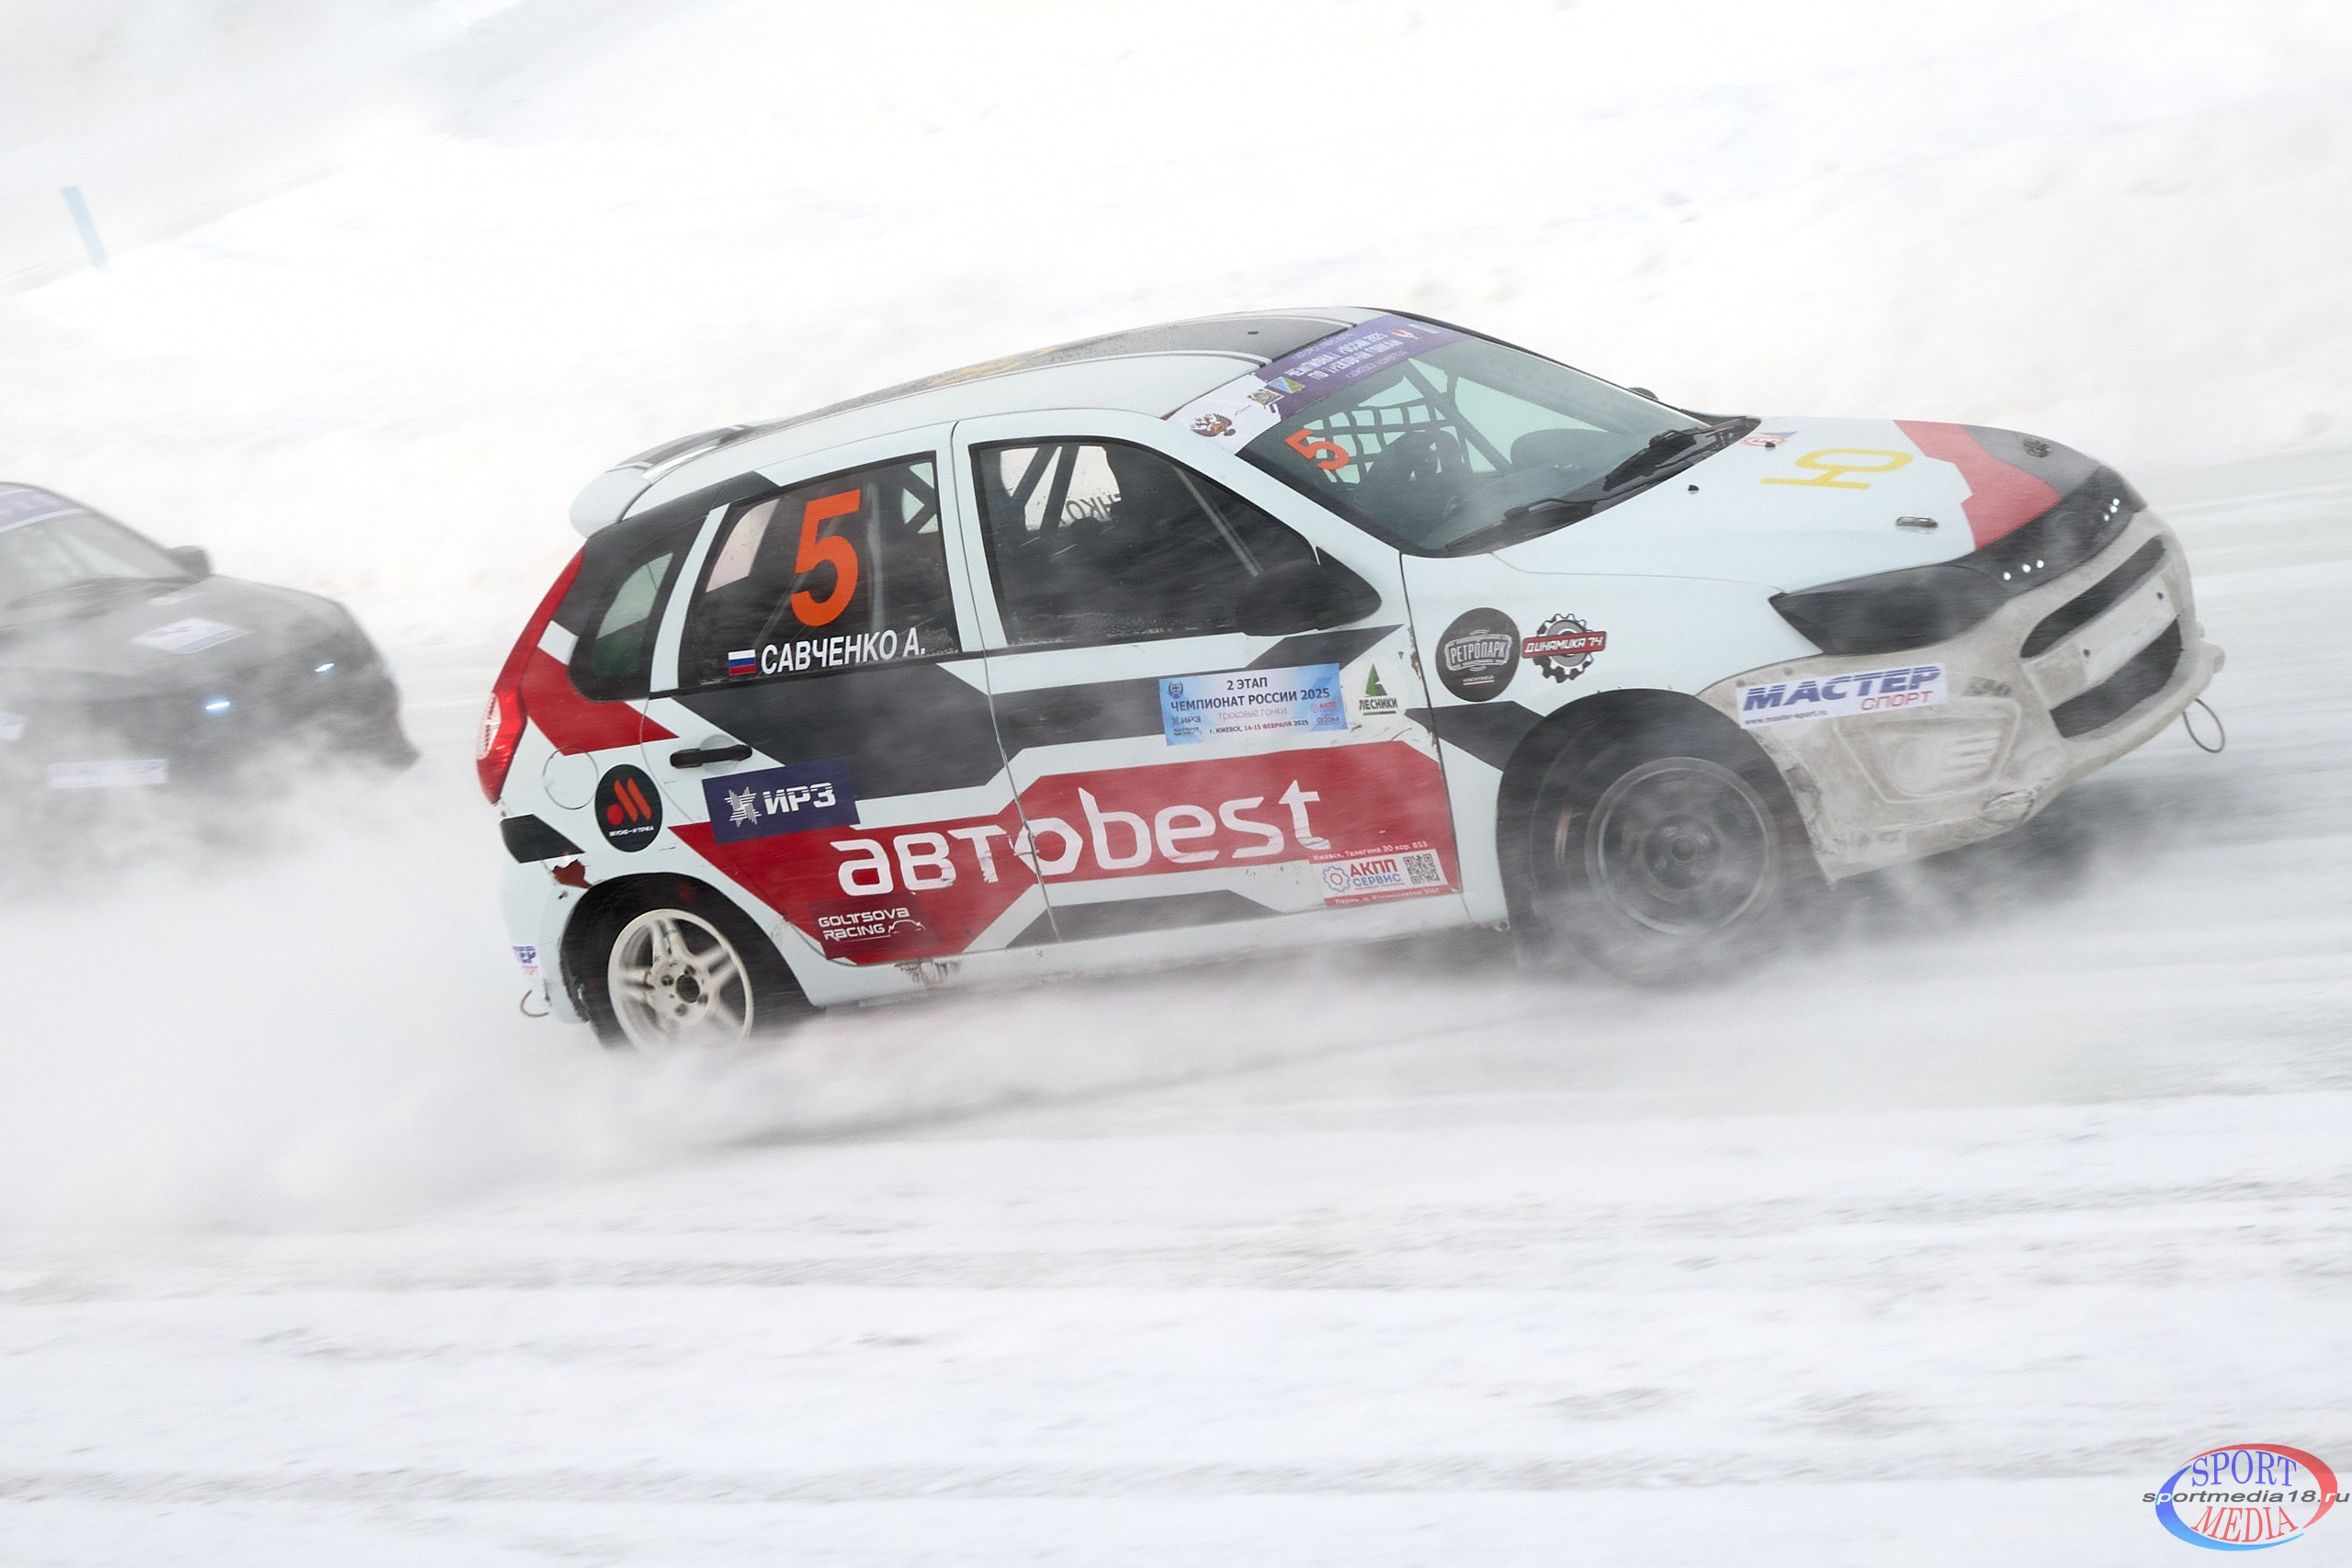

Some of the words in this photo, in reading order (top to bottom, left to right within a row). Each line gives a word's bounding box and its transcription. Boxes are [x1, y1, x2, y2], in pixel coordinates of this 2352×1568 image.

[1284, 428, 1350, 470] 5
[790, 489, 862, 627] 5
[761, 629, 898, 675] САВЧЕНКО
[902, 626, 926, 659] А.
[1450, 638, 1506, 664] РЕТРОПАРК
[1588, 636, 1604, 647] 74
[1227, 680, 1235, 691] 2
[1237, 677, 1268, 690] ЭТАП
[1743, 665, 1941, 711] МАСТЕР
[1170, 695, 1245, 712] ЧЕМПИОНАТ
[1248, 690, 1297, 705] РОССИИ
[1300, 687, 1330, 700] 2025
[1359, 698, 1398, 711] ЛЕСНИКИ
[1860, 690, 1933, 711] СПОРТ
[763, 782, 837, 816] ИРЗ
[1351, 858, 1398, 877] АКПП
[1352, 874, 1401, 886] СЕРВИС
[818, 907, 910, 928] GOLTSOVA
[822, 923, 886, 942] RACING
